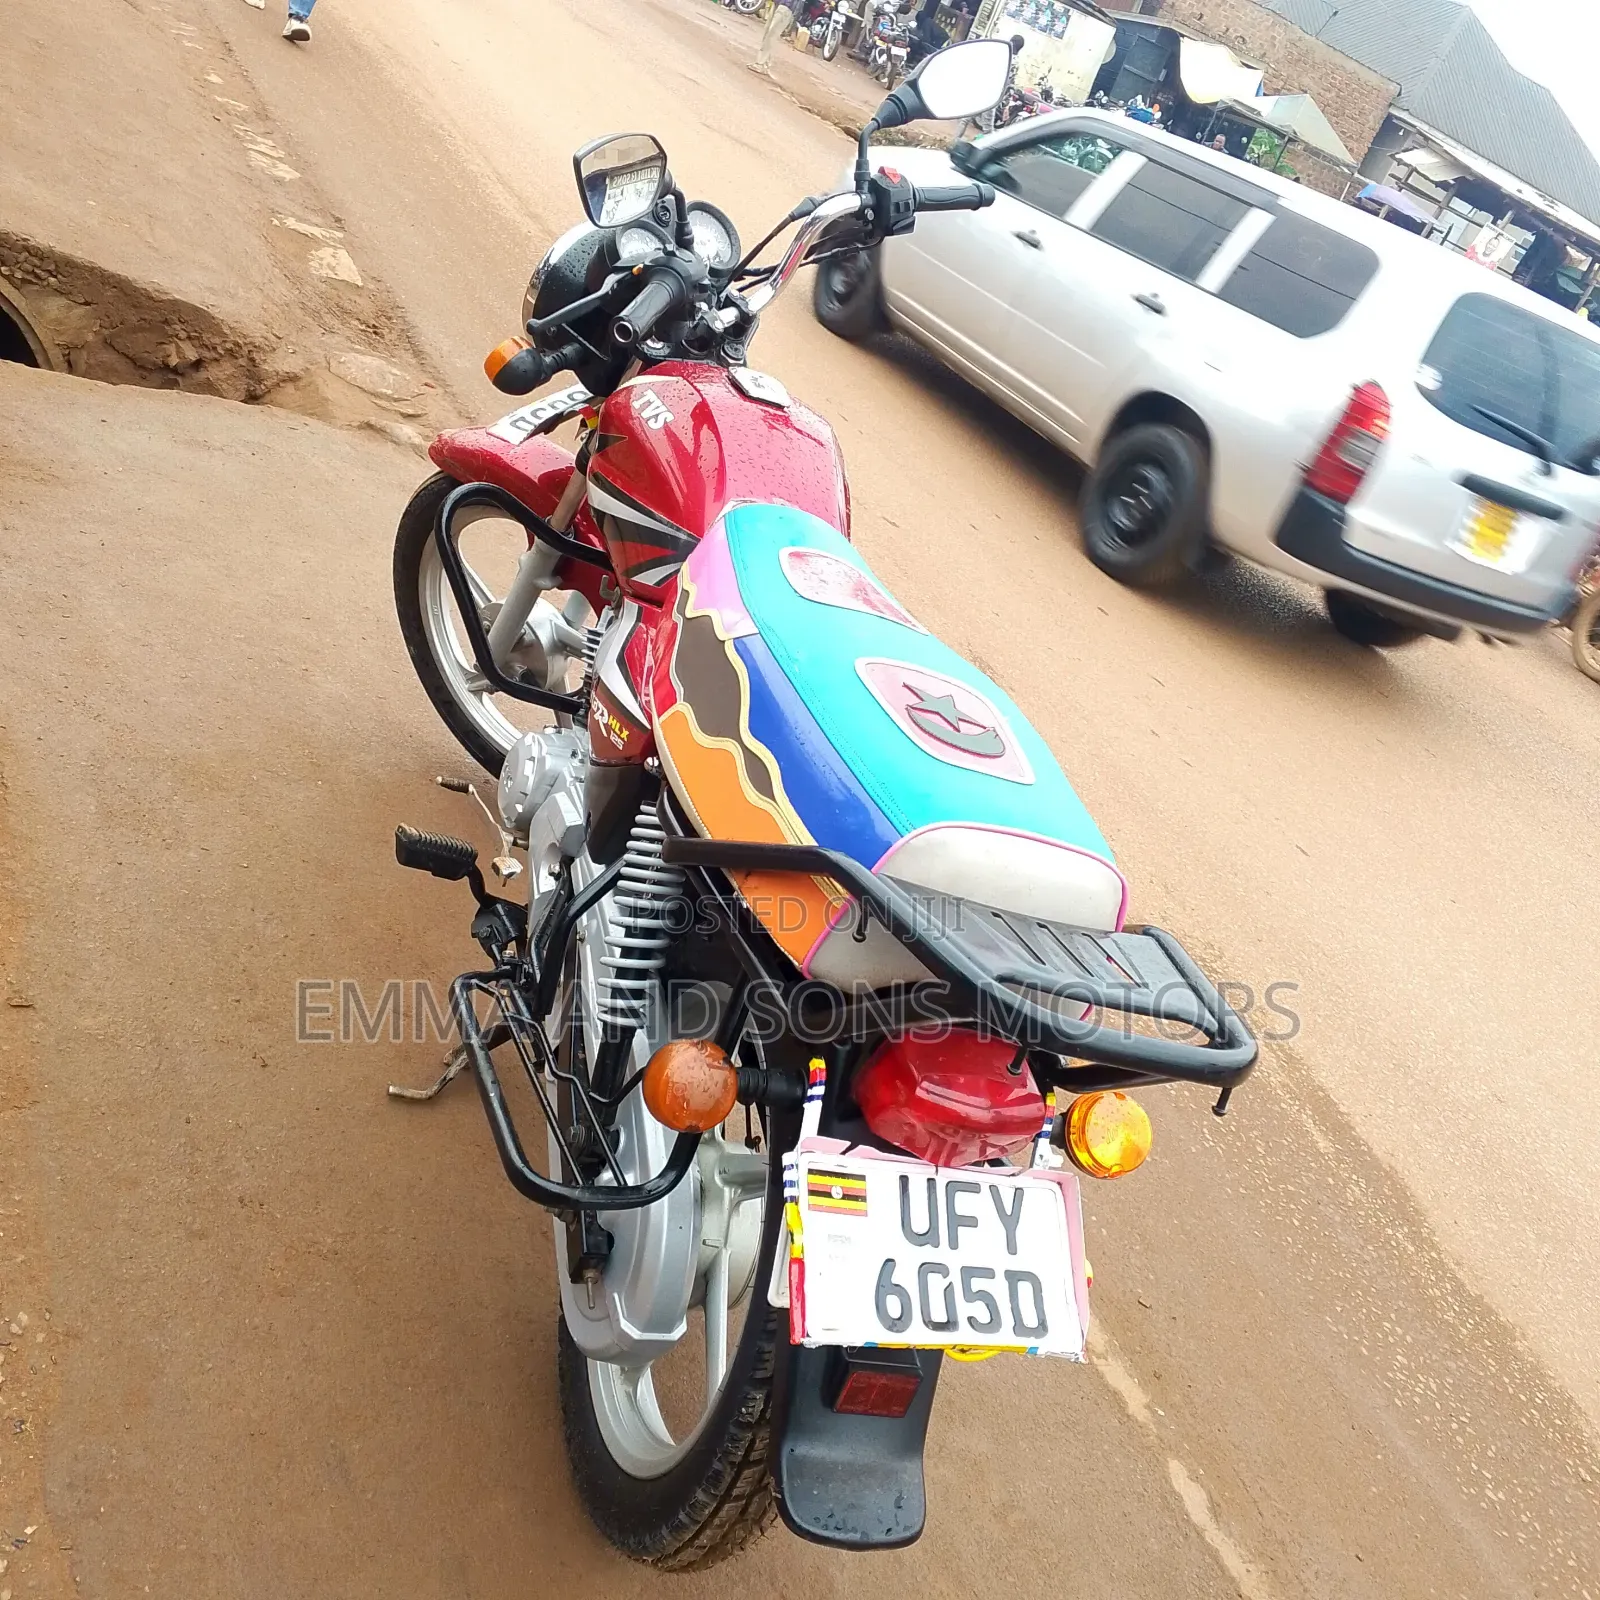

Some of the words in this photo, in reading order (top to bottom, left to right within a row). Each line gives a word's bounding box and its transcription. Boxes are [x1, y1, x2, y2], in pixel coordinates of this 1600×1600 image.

[632, 388, 675, 430] TVS
[608, 714, 630, 742] HLX
[610, 729, 625, 751] 125
[899, 1175, 1024, 1255] UFY
[874, 1258, 1049, 1339] 605D
